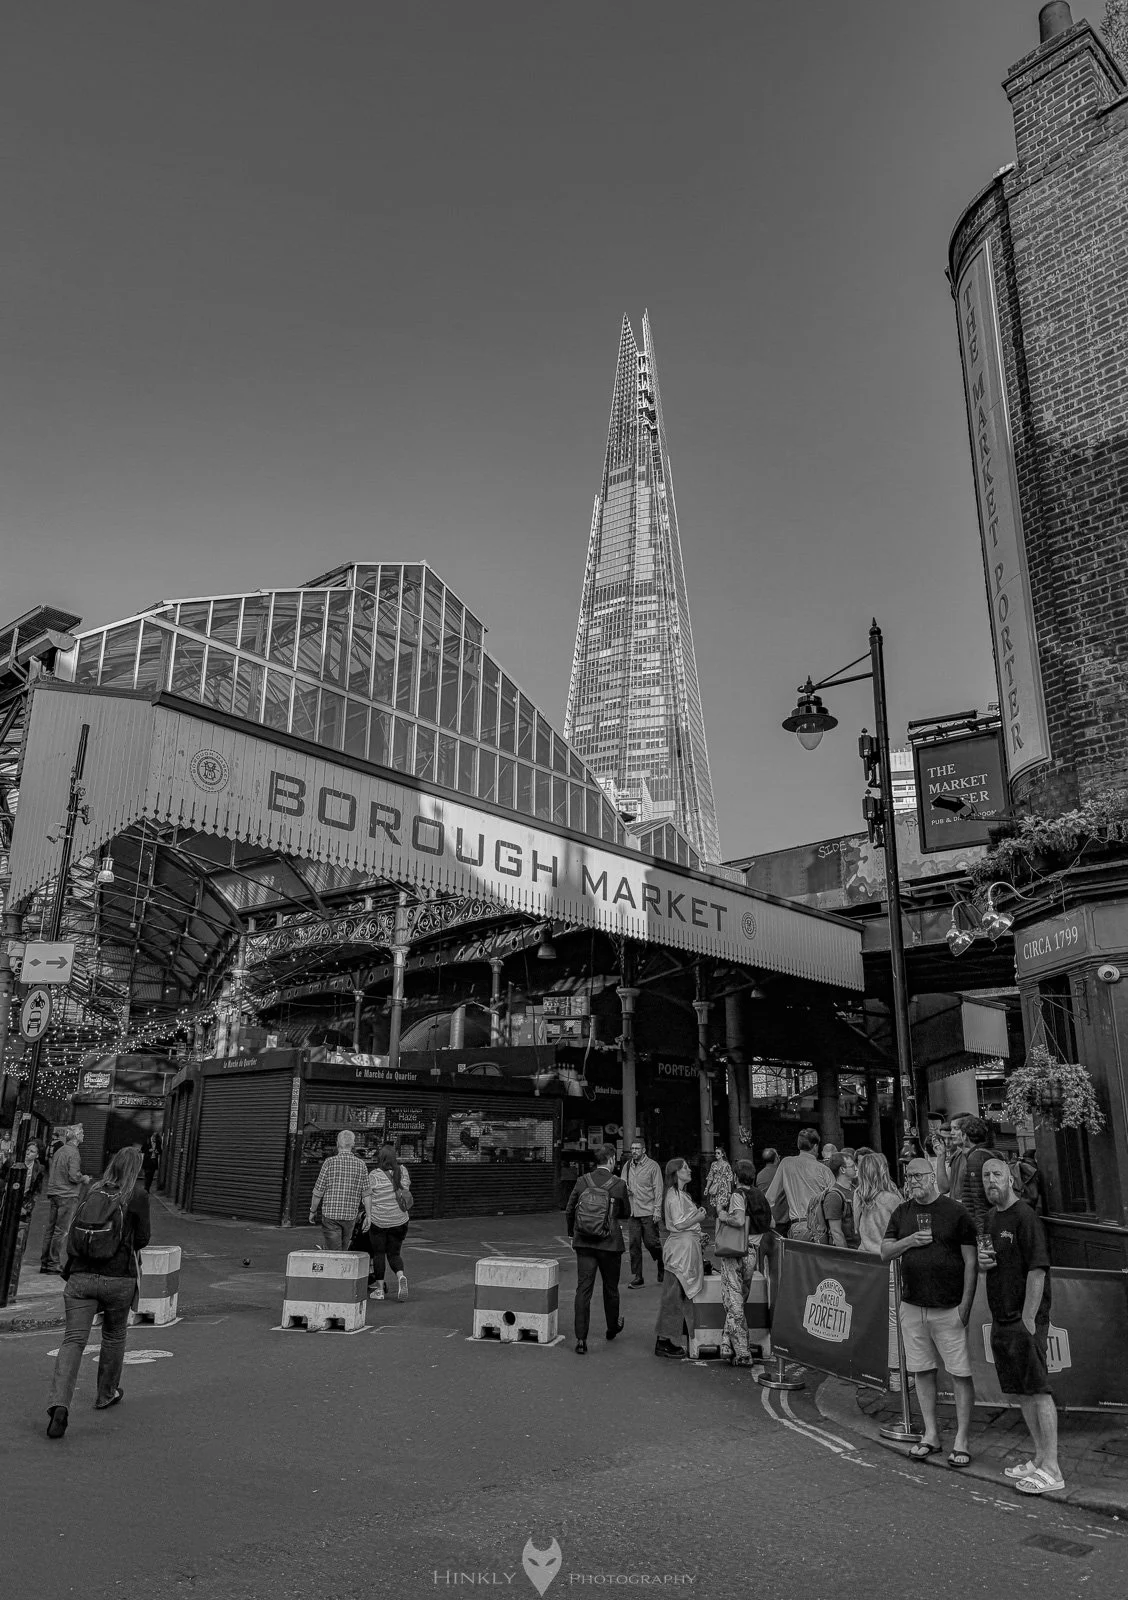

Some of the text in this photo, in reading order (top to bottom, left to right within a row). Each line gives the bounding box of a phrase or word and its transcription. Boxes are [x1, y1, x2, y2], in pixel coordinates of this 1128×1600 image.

[972, 371, 999, 548] MARKET
[994, 562, 1024, 754] PORTER
[927, 763, 956, 778] THE
[928, 773, 988, 795] MARKET
[268, 770, 728, 932] BOROUGH MARKET
[817, 840, 848, 859] SIDE
[1023, 926, 1079, 960] CIRCA 1799
[355, 1069, 418, 1082] Le Marché du Quartier
[388, 1120, 425, 1130] Lemonade
[398, 1112, 417, 1121] Haze
[808, 1303, 847, 1334] PORETTI
